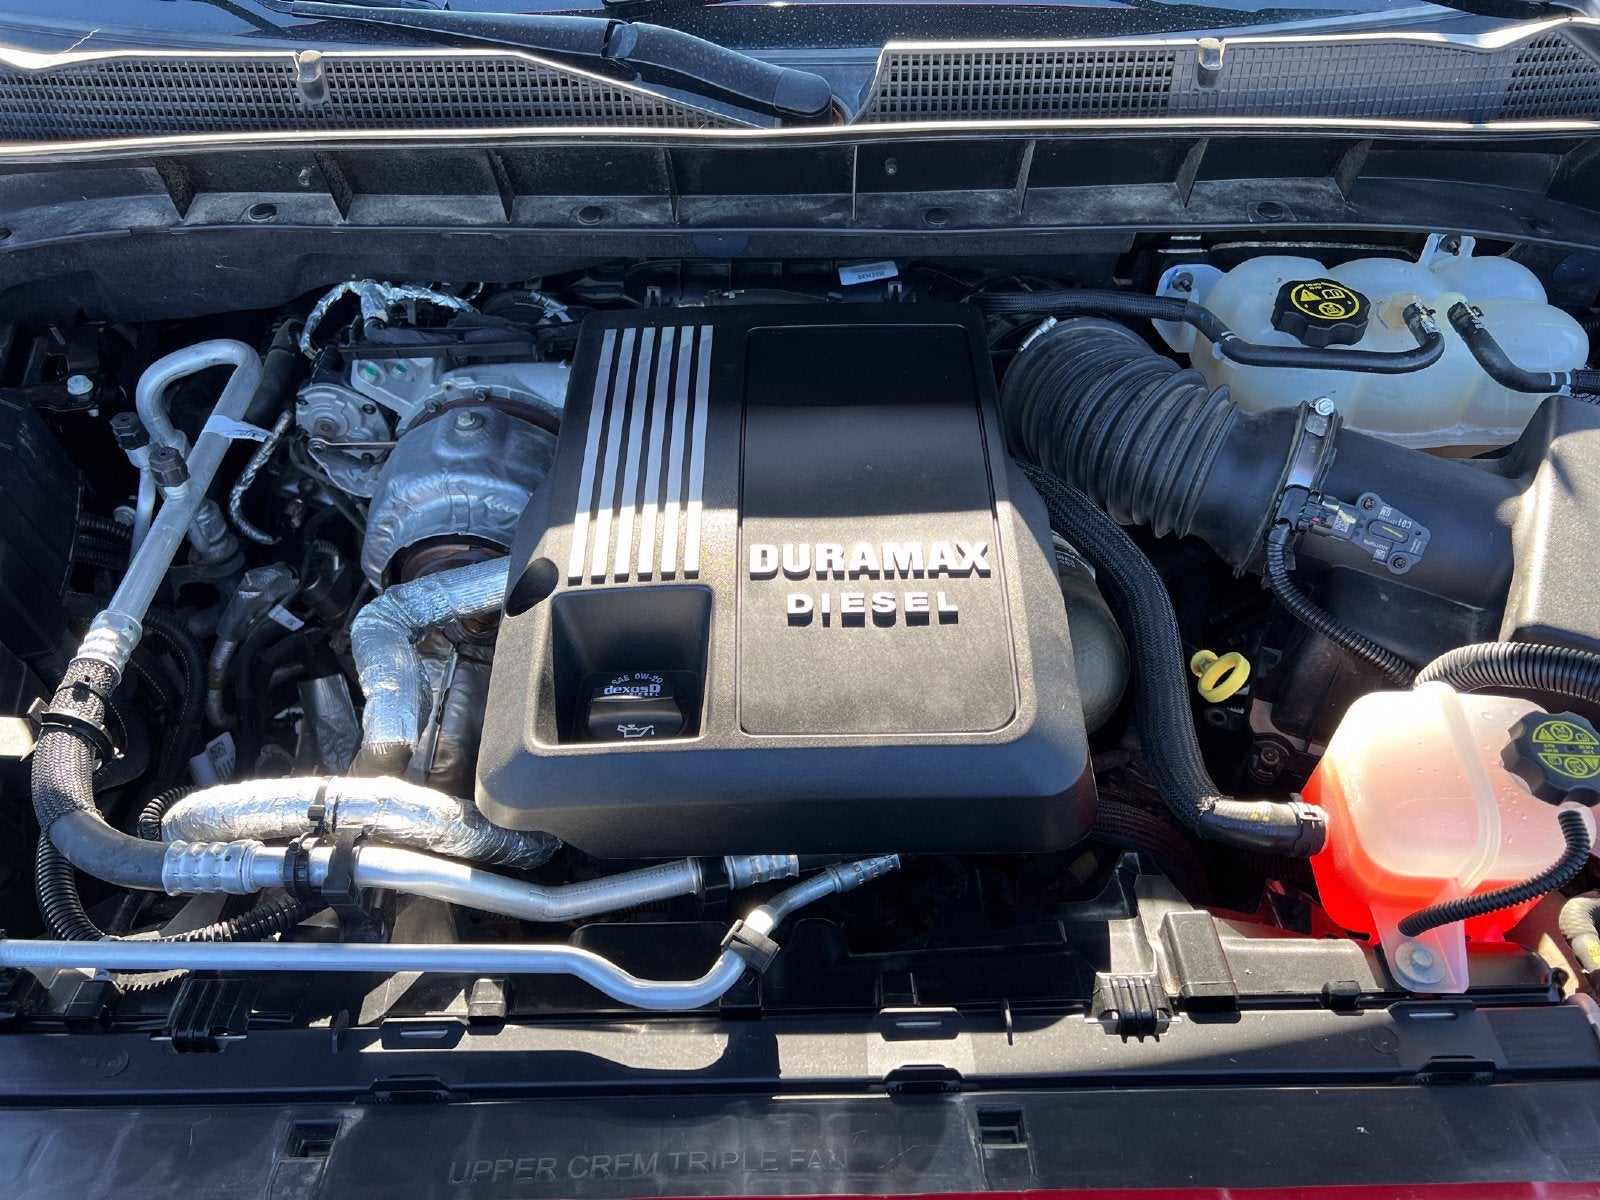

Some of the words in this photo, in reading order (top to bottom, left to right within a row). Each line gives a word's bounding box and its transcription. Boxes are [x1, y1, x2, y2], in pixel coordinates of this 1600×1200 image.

[749, 541, 992, 579] DURAMAX
[786, 591, 959, 618] DIESEL
[612, 675, 629, 685] SAE
[635, 673, 663, 684] 0W-20
[448, 1157, 558, 1185] UPPER
[567, 1152, 659, 1180] CRFM
[668, 1149, 779, 1174] TRIPLE
[789, 1148, 849, 1172] FAN
